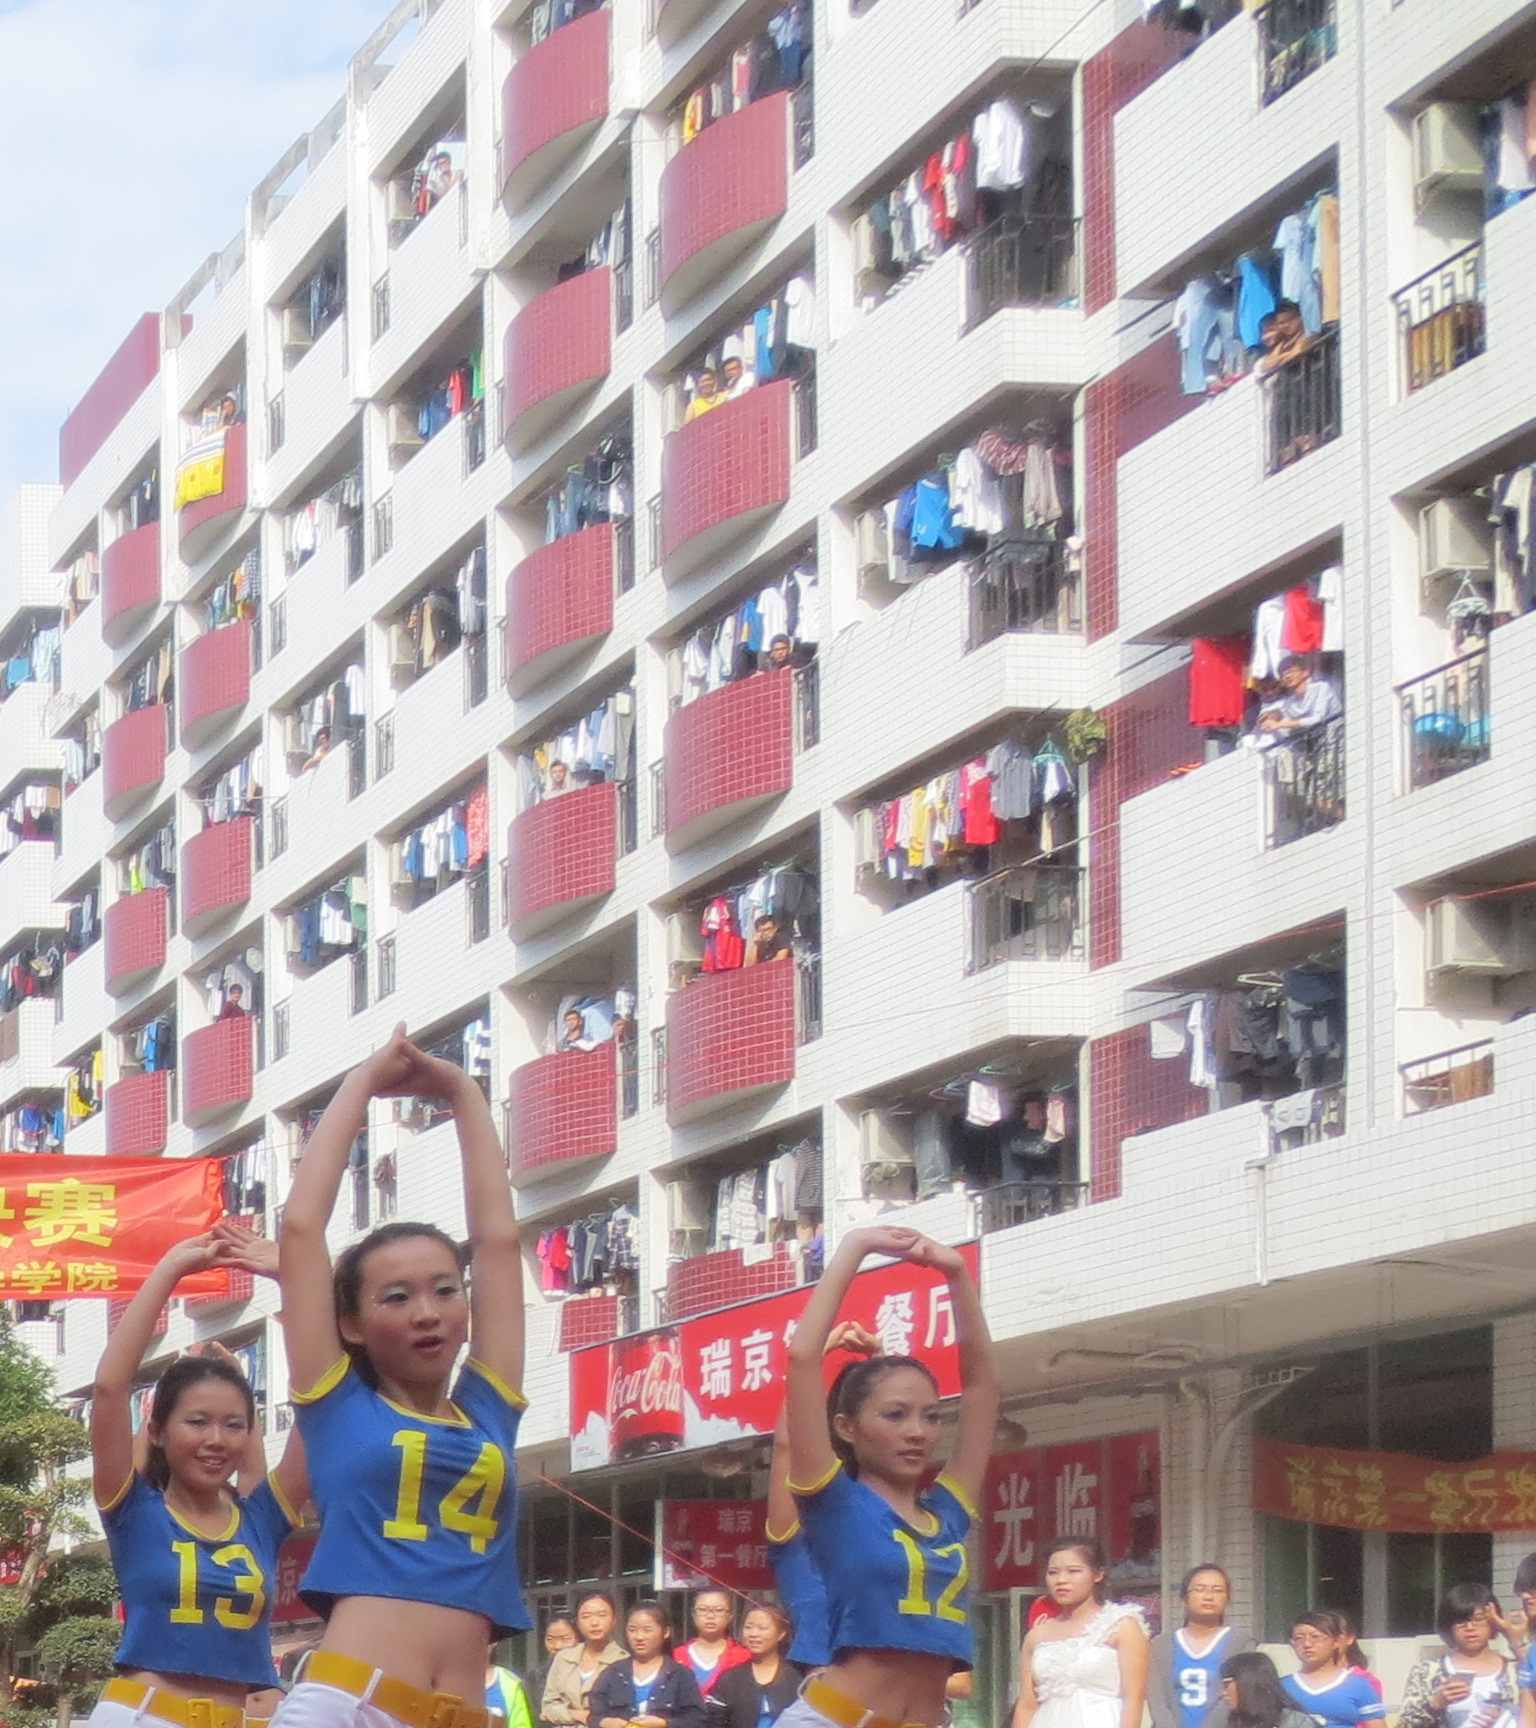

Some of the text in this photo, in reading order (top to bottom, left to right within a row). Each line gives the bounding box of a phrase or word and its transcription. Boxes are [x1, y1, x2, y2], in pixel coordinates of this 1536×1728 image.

[611, 1337, 682, 1413] Coca-Cola
[382, 1430, 505, 1554] 14
[170, 1540, 266, 1630] 13
[893, 1529, 969, 1624] 12
[1179, 1668, 1208, 1707] 9
